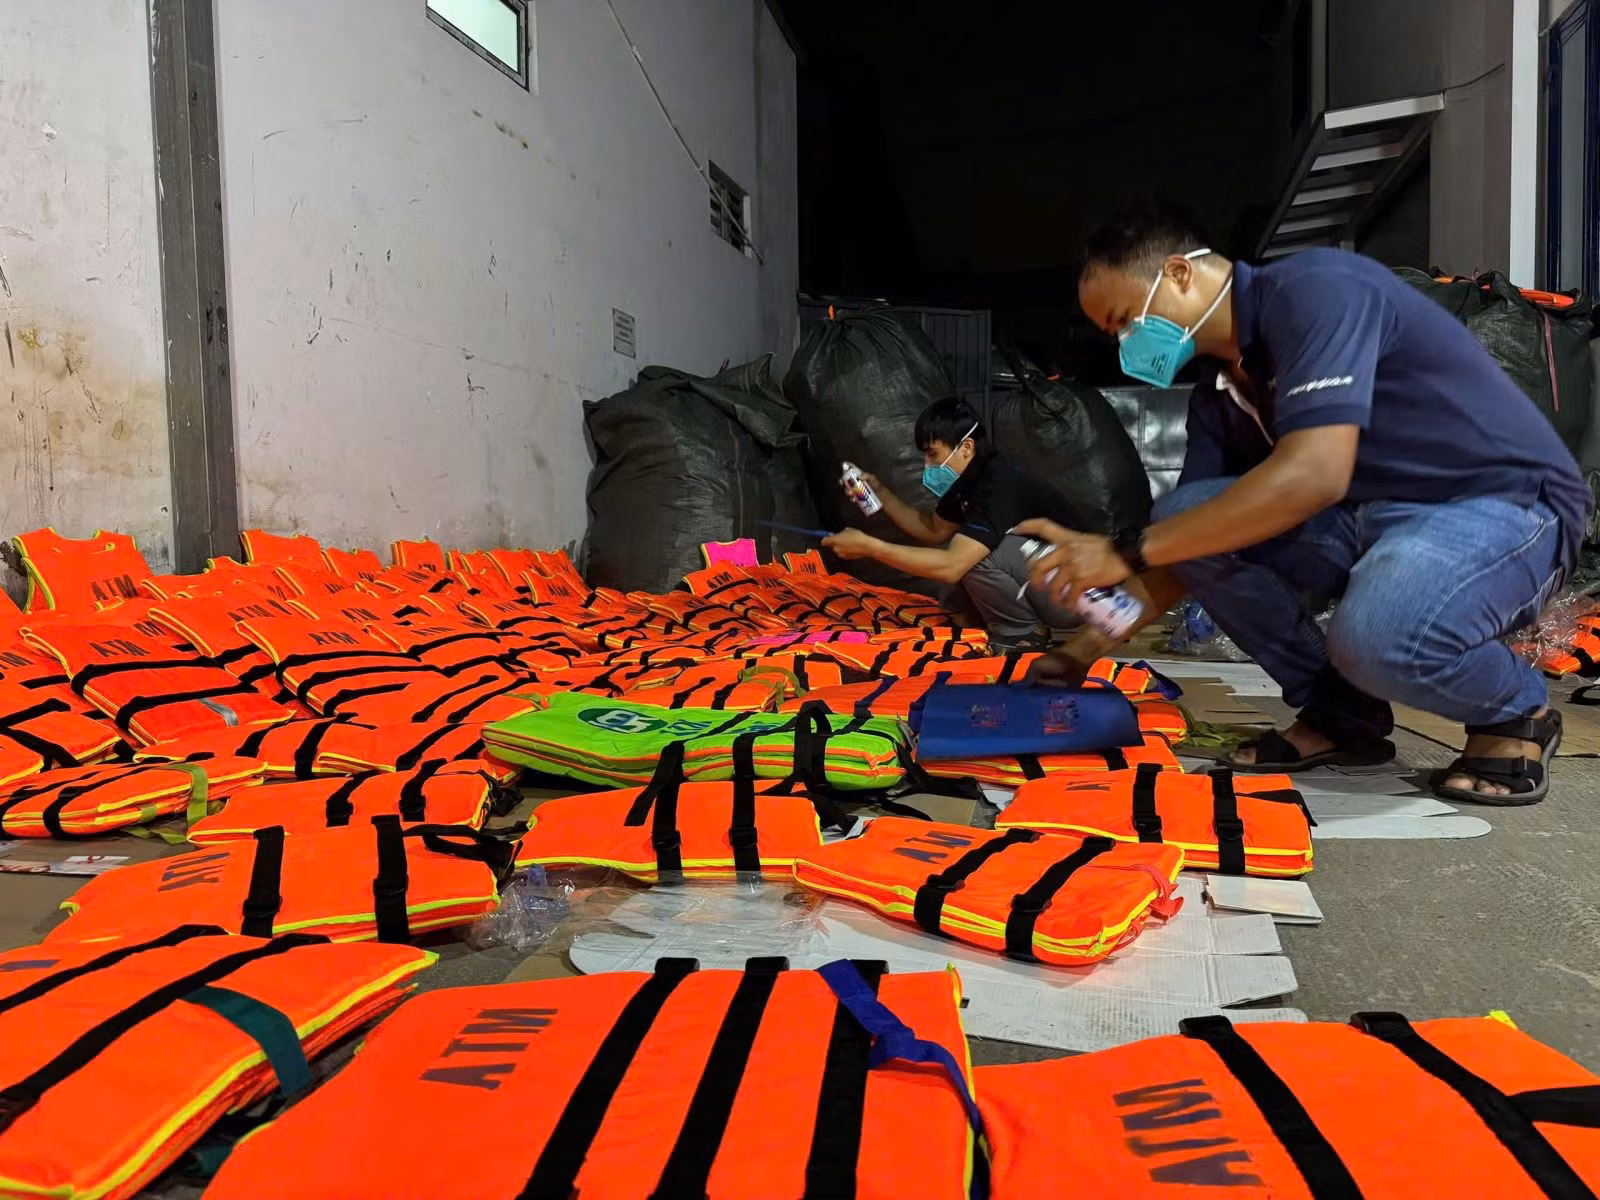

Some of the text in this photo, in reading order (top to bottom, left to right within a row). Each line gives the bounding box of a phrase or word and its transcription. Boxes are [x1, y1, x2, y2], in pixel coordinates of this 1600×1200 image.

[91, 574, 140, 601] ATM
[891, 830, 977, 866] ATM
[419, 1008, 560, 1091] ATM
[1112, 1078, 1267, 1187] ATM
